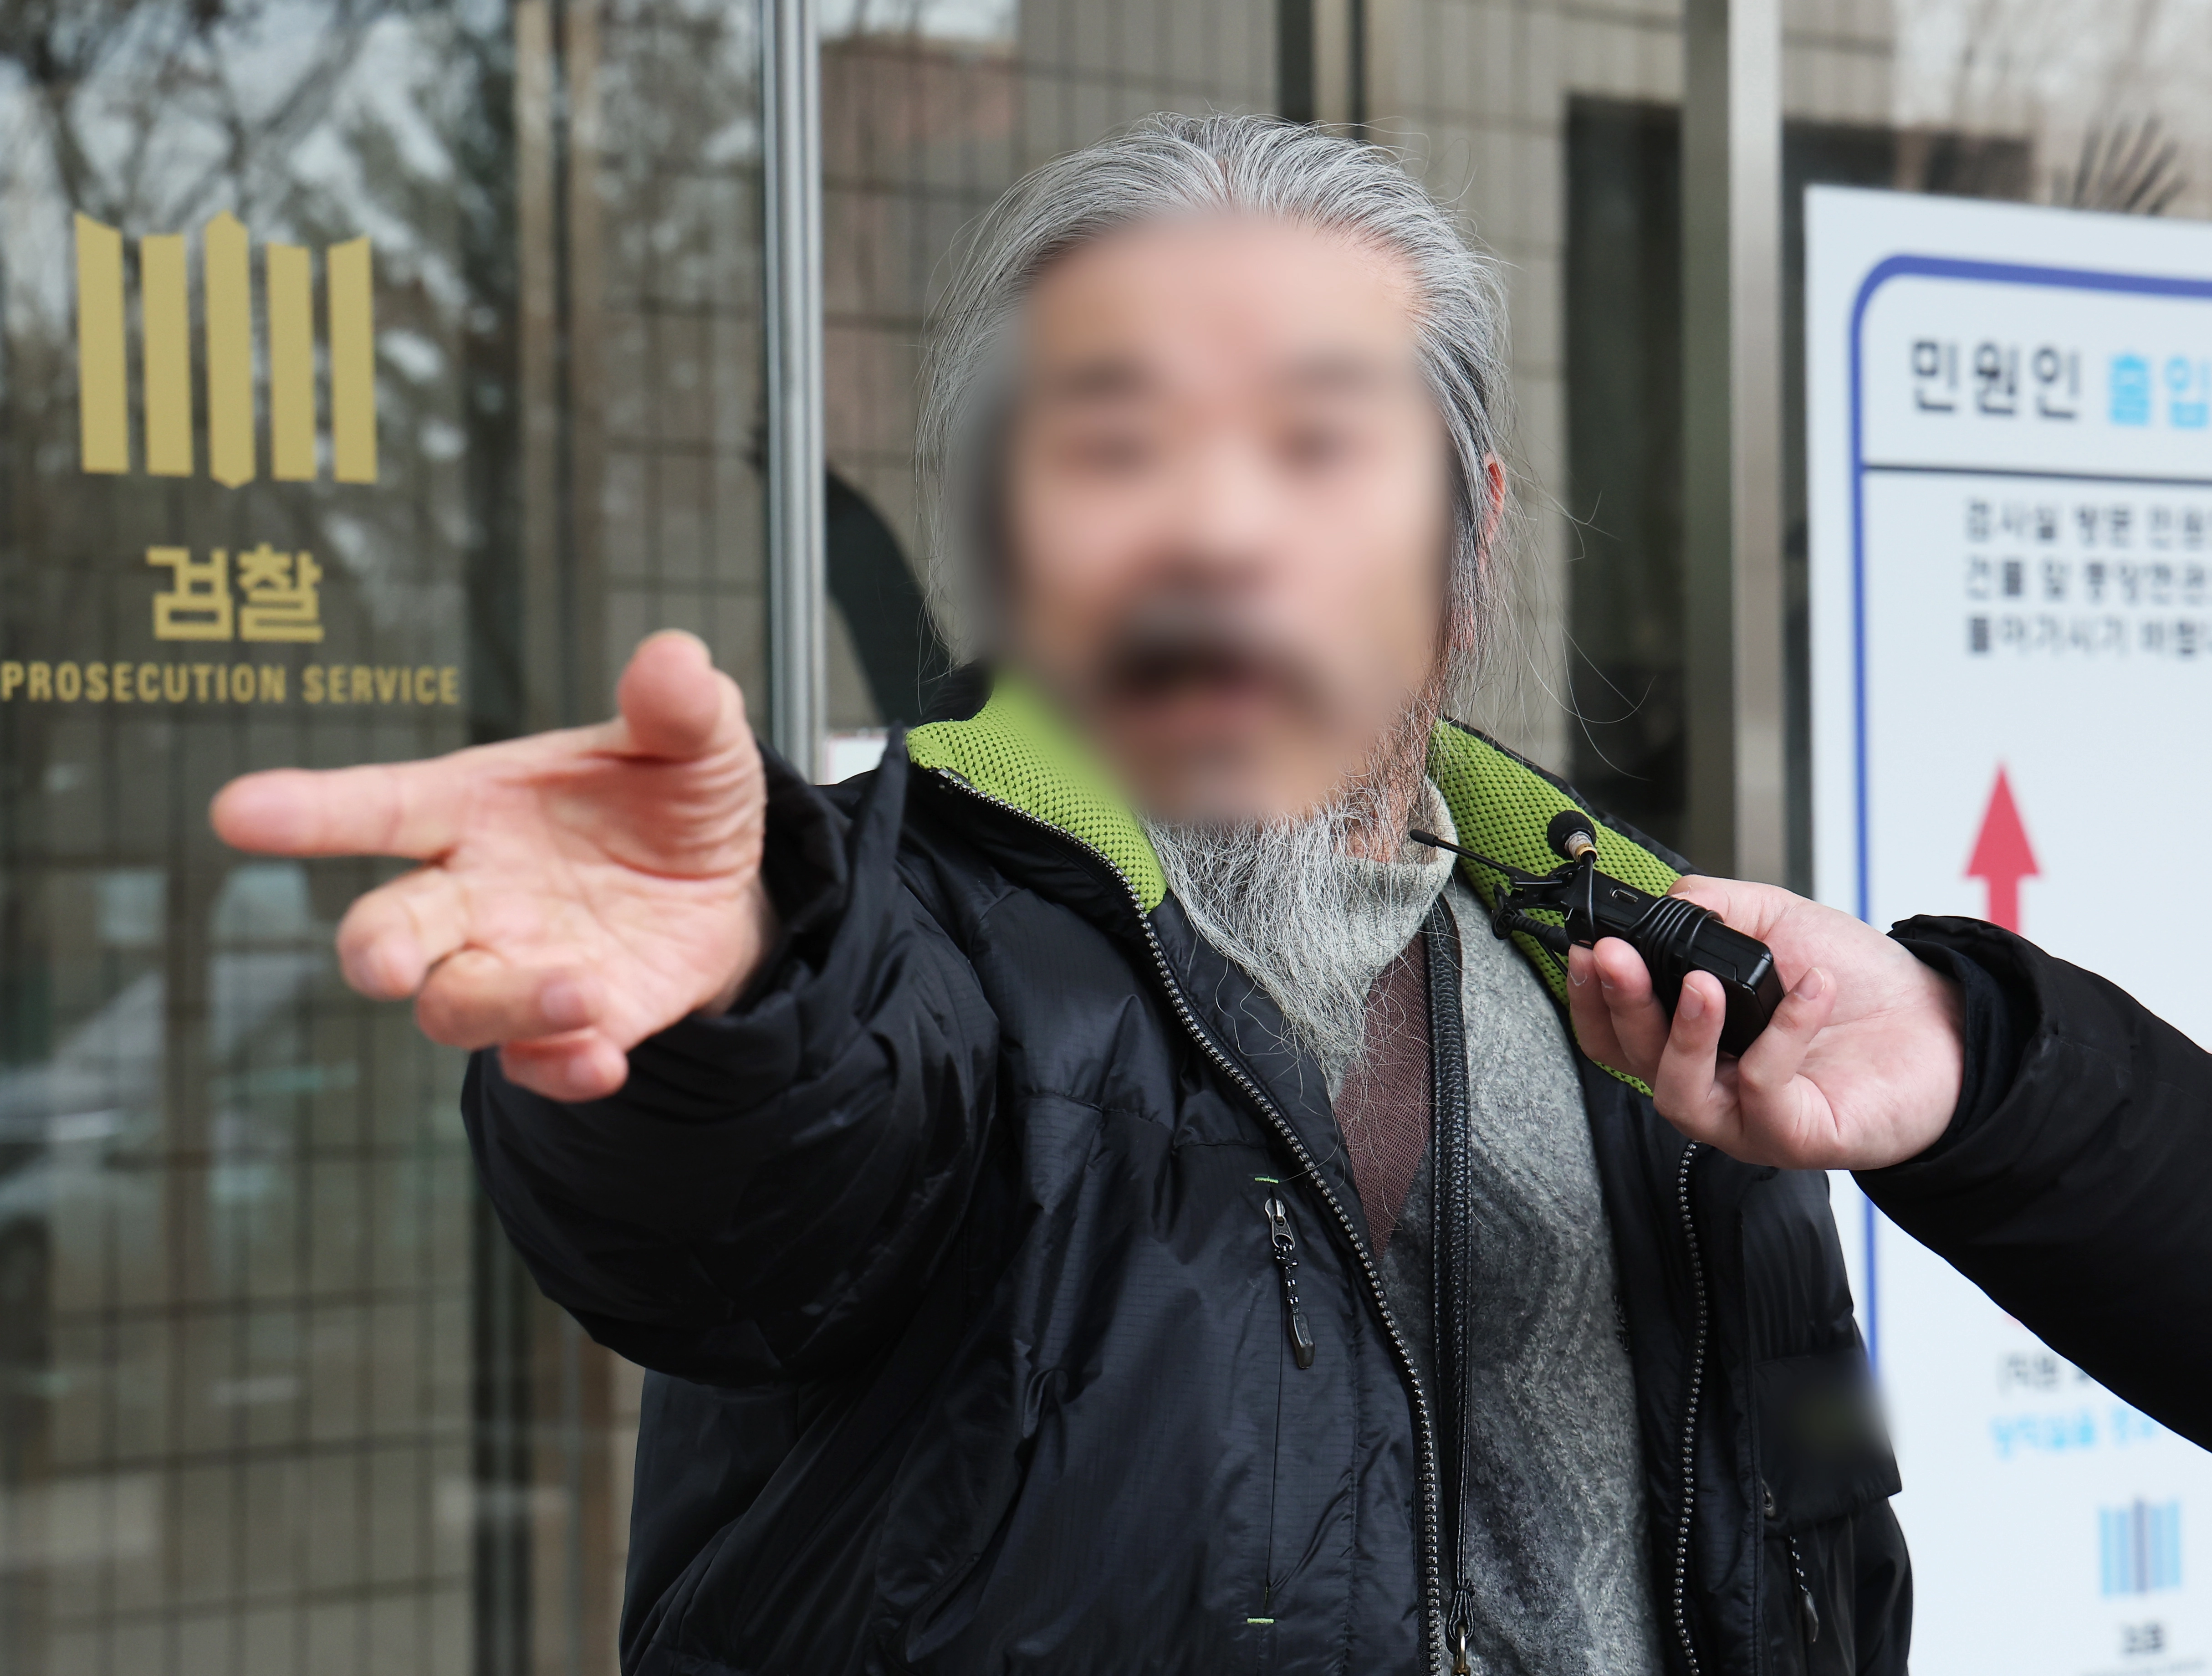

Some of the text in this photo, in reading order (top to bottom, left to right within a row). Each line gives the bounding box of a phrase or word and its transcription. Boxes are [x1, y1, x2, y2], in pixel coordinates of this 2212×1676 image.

[1911, 338, 2080, 420] 민원인
[147, 543, 323, 642] 검찰
[0, 661, 458, 705] PROSECUTION SERVICE
